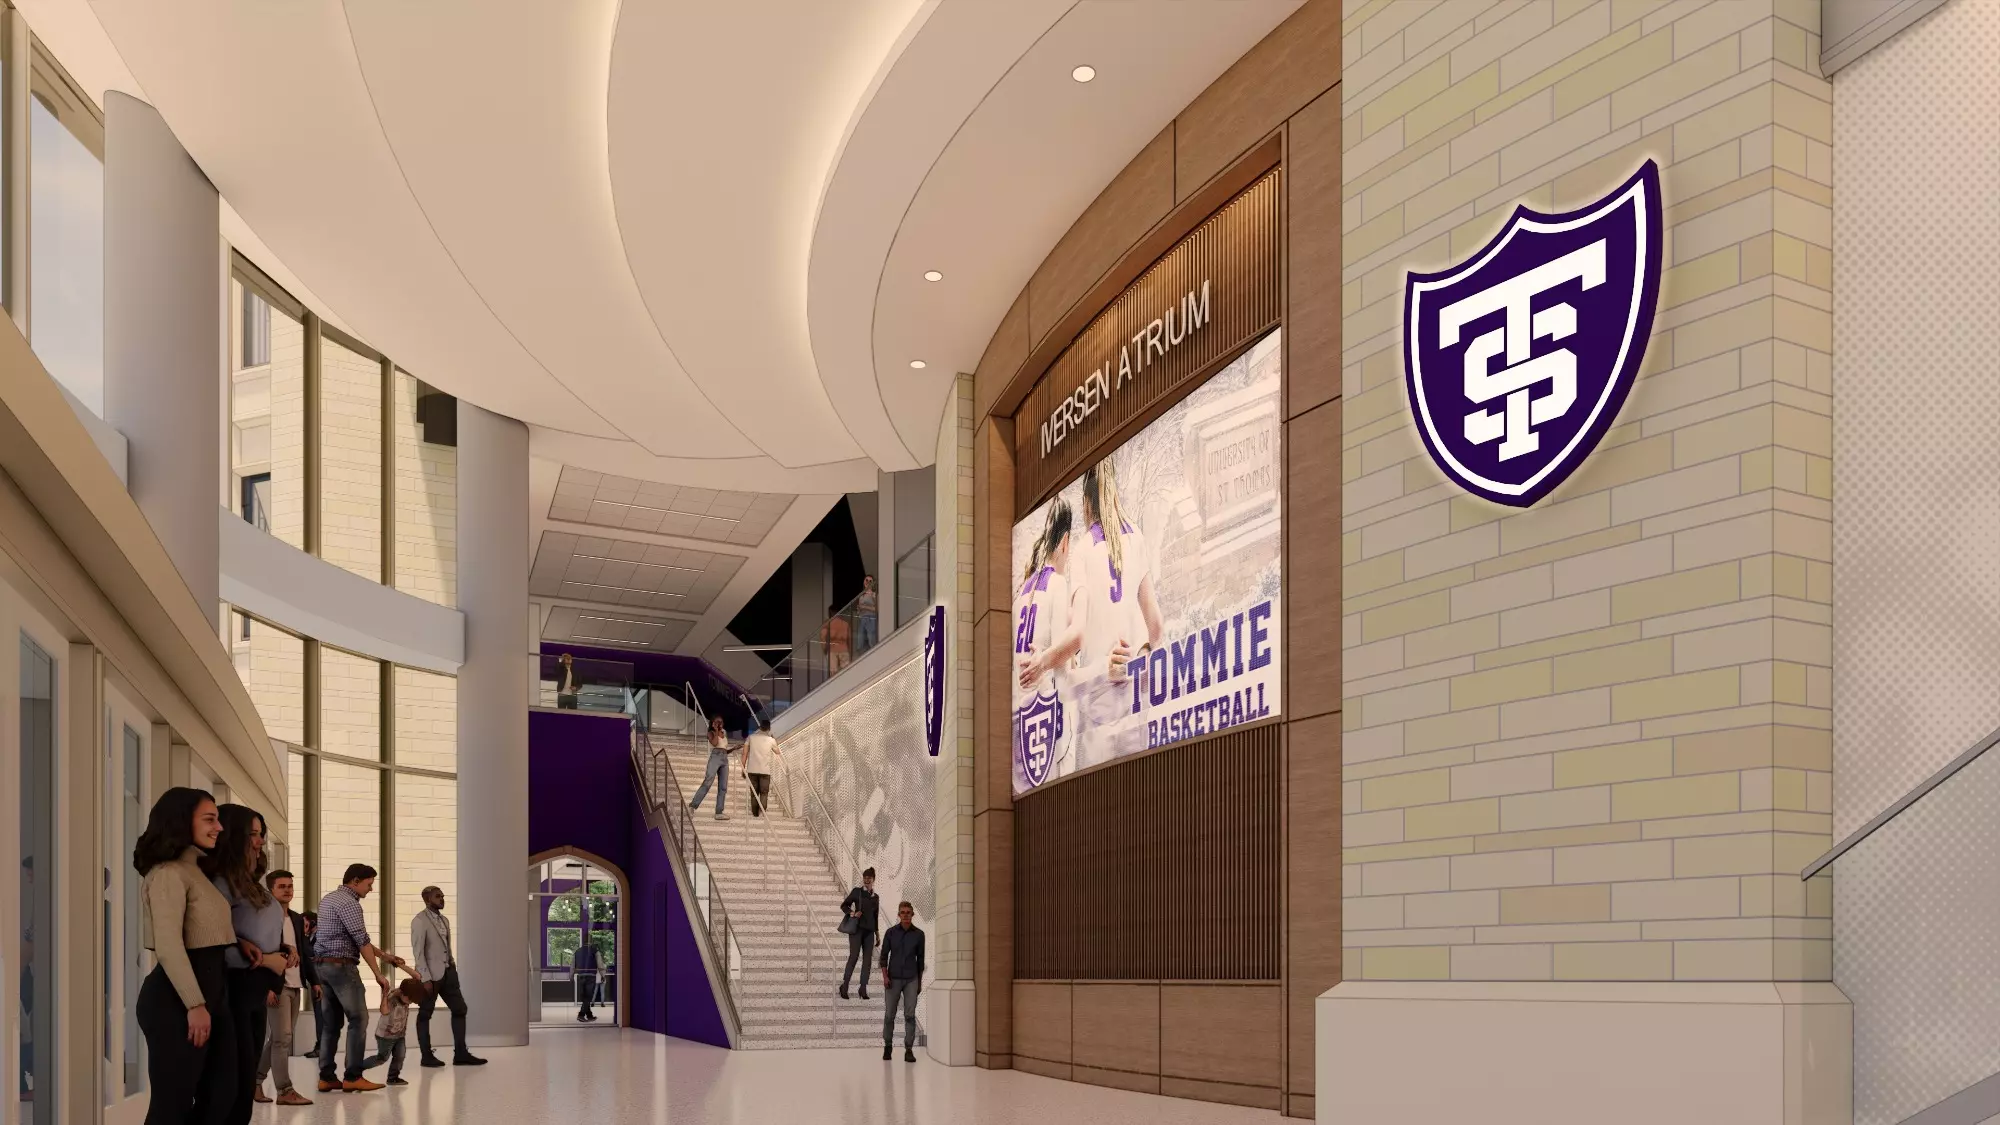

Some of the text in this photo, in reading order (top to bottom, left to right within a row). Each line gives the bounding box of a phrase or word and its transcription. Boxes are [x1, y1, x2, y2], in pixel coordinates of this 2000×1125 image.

[1041, 279, 1210, 459] IVERSEN ATRIUM
[1015, 603, 1038, 653] 20
[1126, 600, 1272, 715] TOMMIE
[1147, 682, 1269, 749] BASKETBALL
